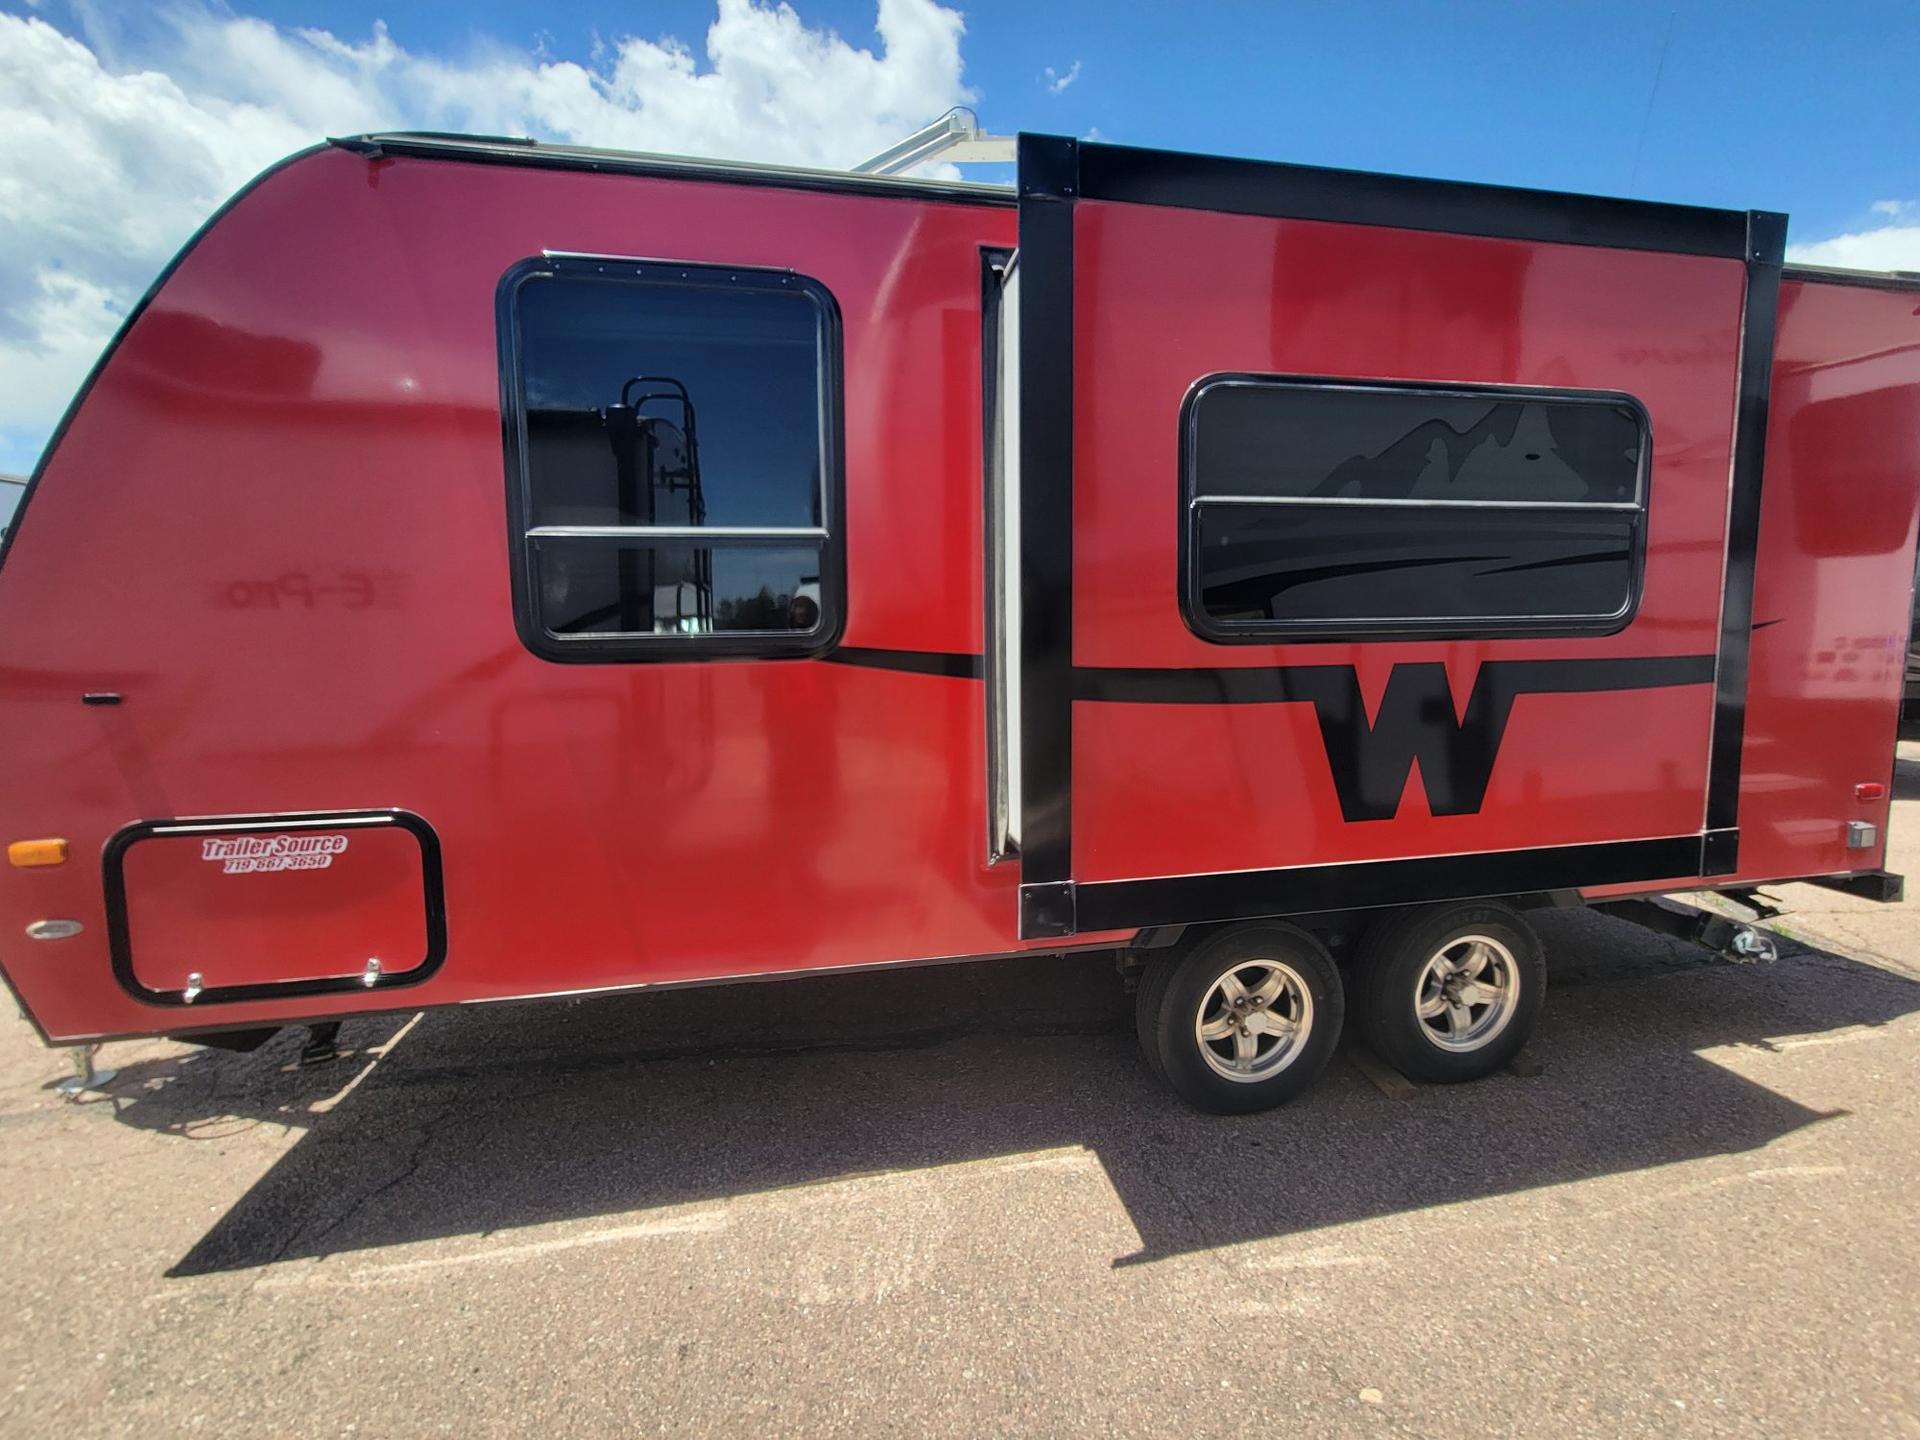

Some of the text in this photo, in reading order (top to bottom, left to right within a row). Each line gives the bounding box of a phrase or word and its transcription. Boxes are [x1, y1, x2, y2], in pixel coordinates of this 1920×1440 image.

[1313, 660, 1517, 823] W
[204, 836, 345, 858] Trailer Source
